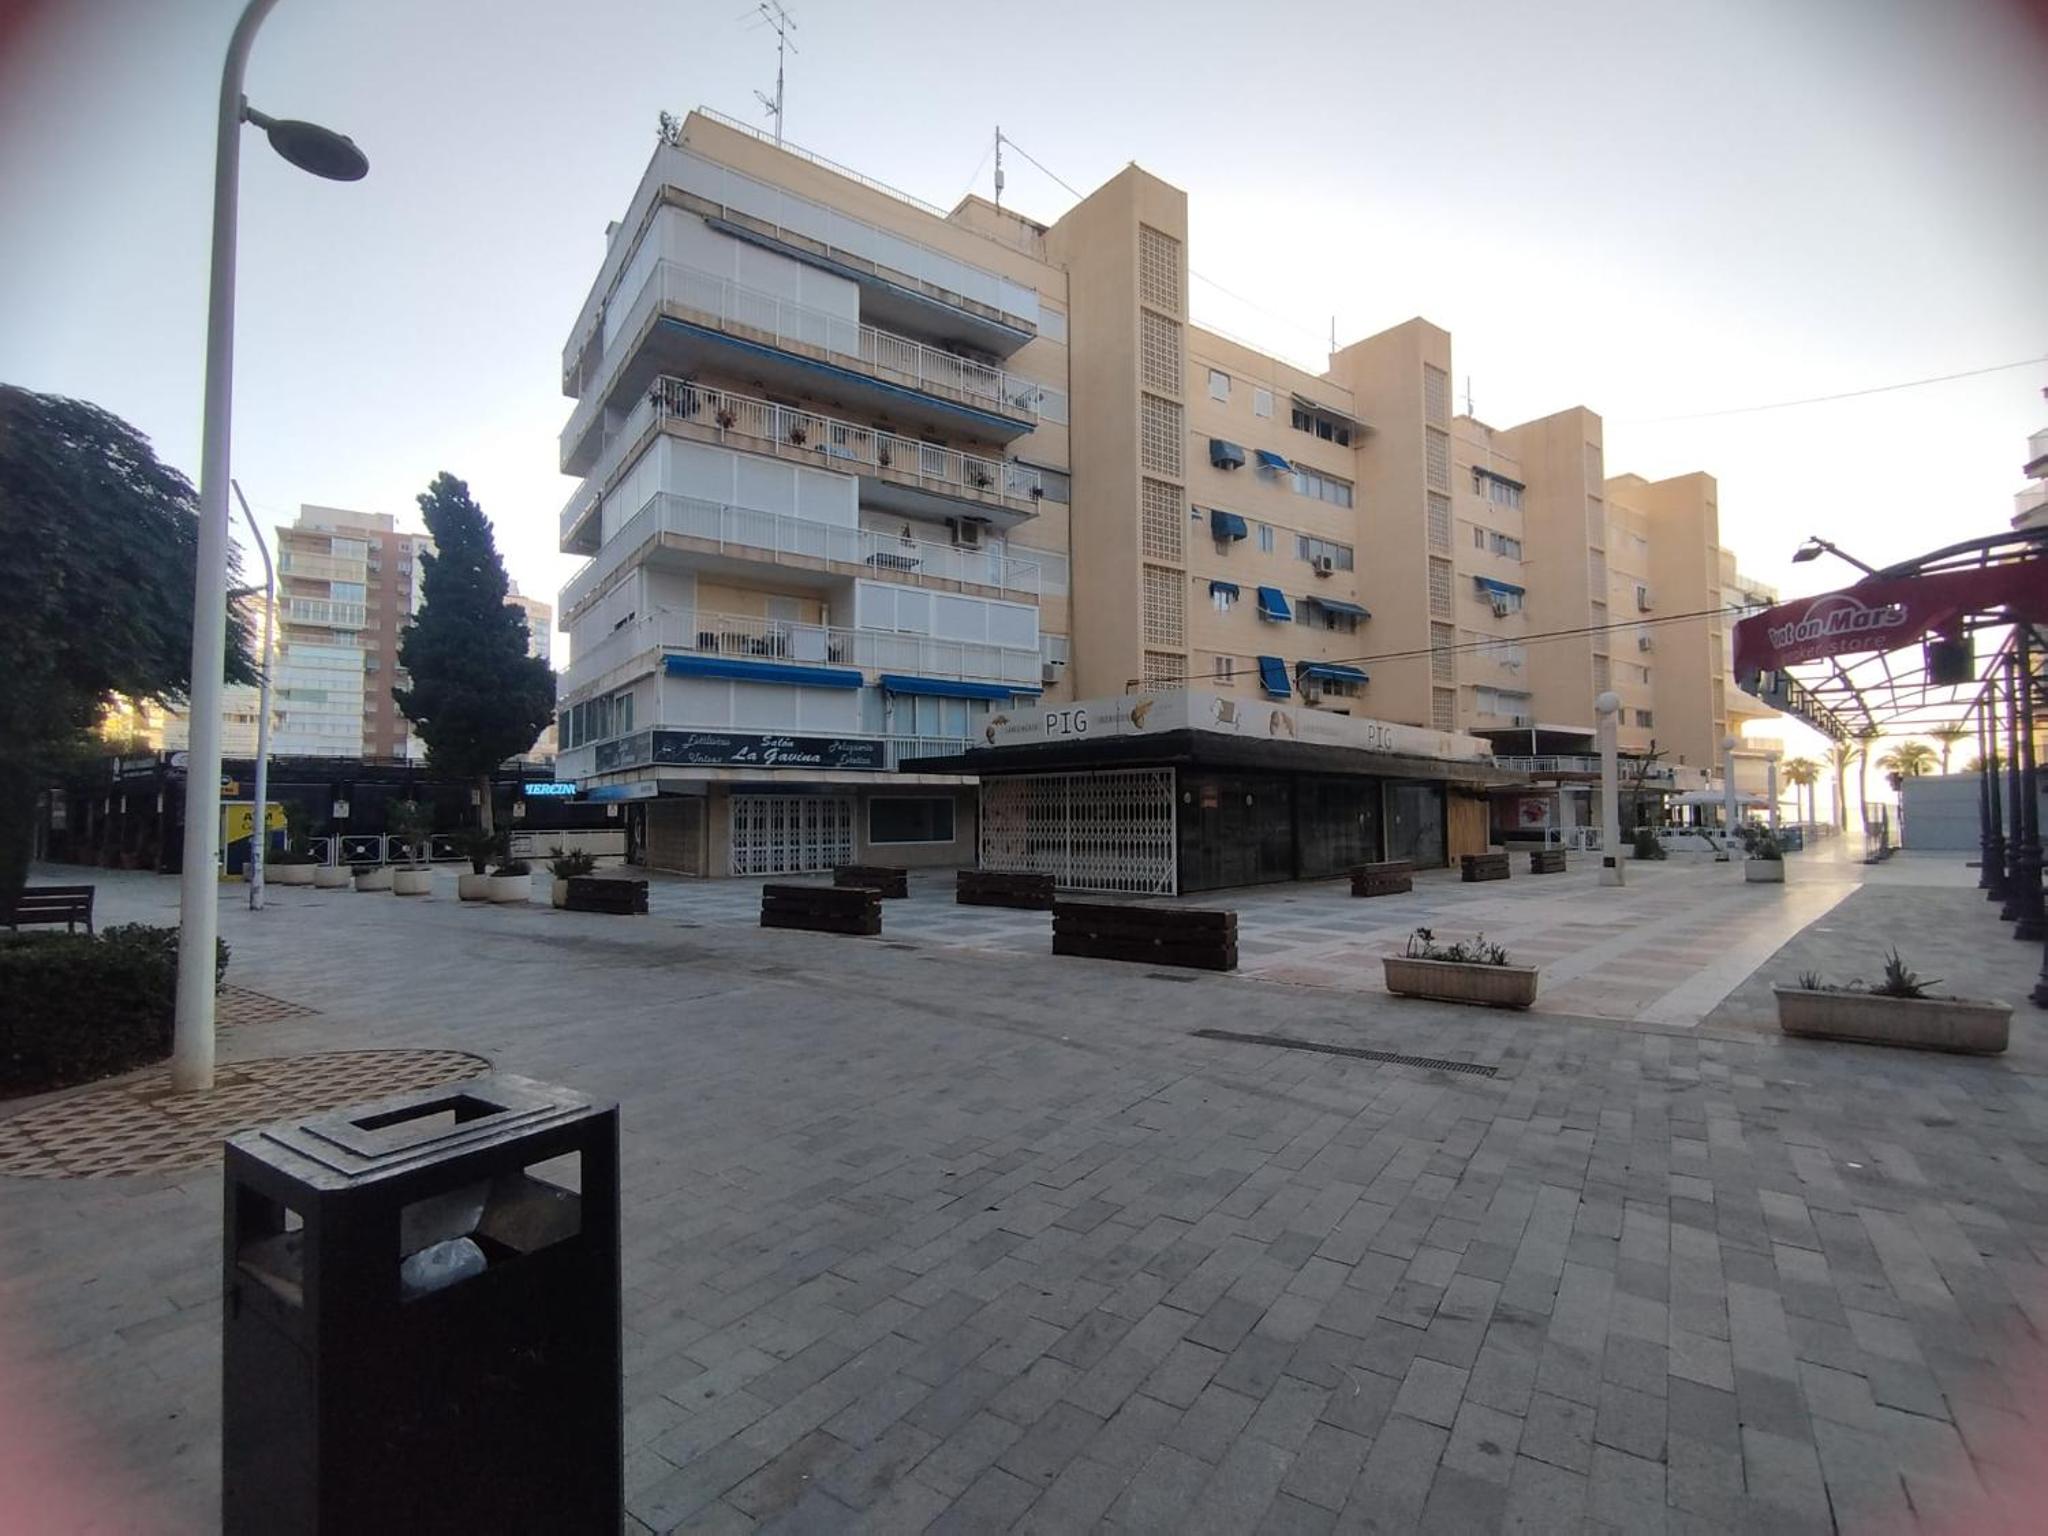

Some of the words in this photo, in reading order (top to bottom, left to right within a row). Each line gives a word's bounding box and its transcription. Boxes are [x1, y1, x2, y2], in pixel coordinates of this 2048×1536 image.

[1795, 618, 1824, 642] on
[1825, 604, 1907, 634] Mars
[1046, 709, 1087, 735] PIG
[1368, 724, 1392, 750] PIG
[731, 747, 758, 761] La
[244, 812, 272, 821] AM
